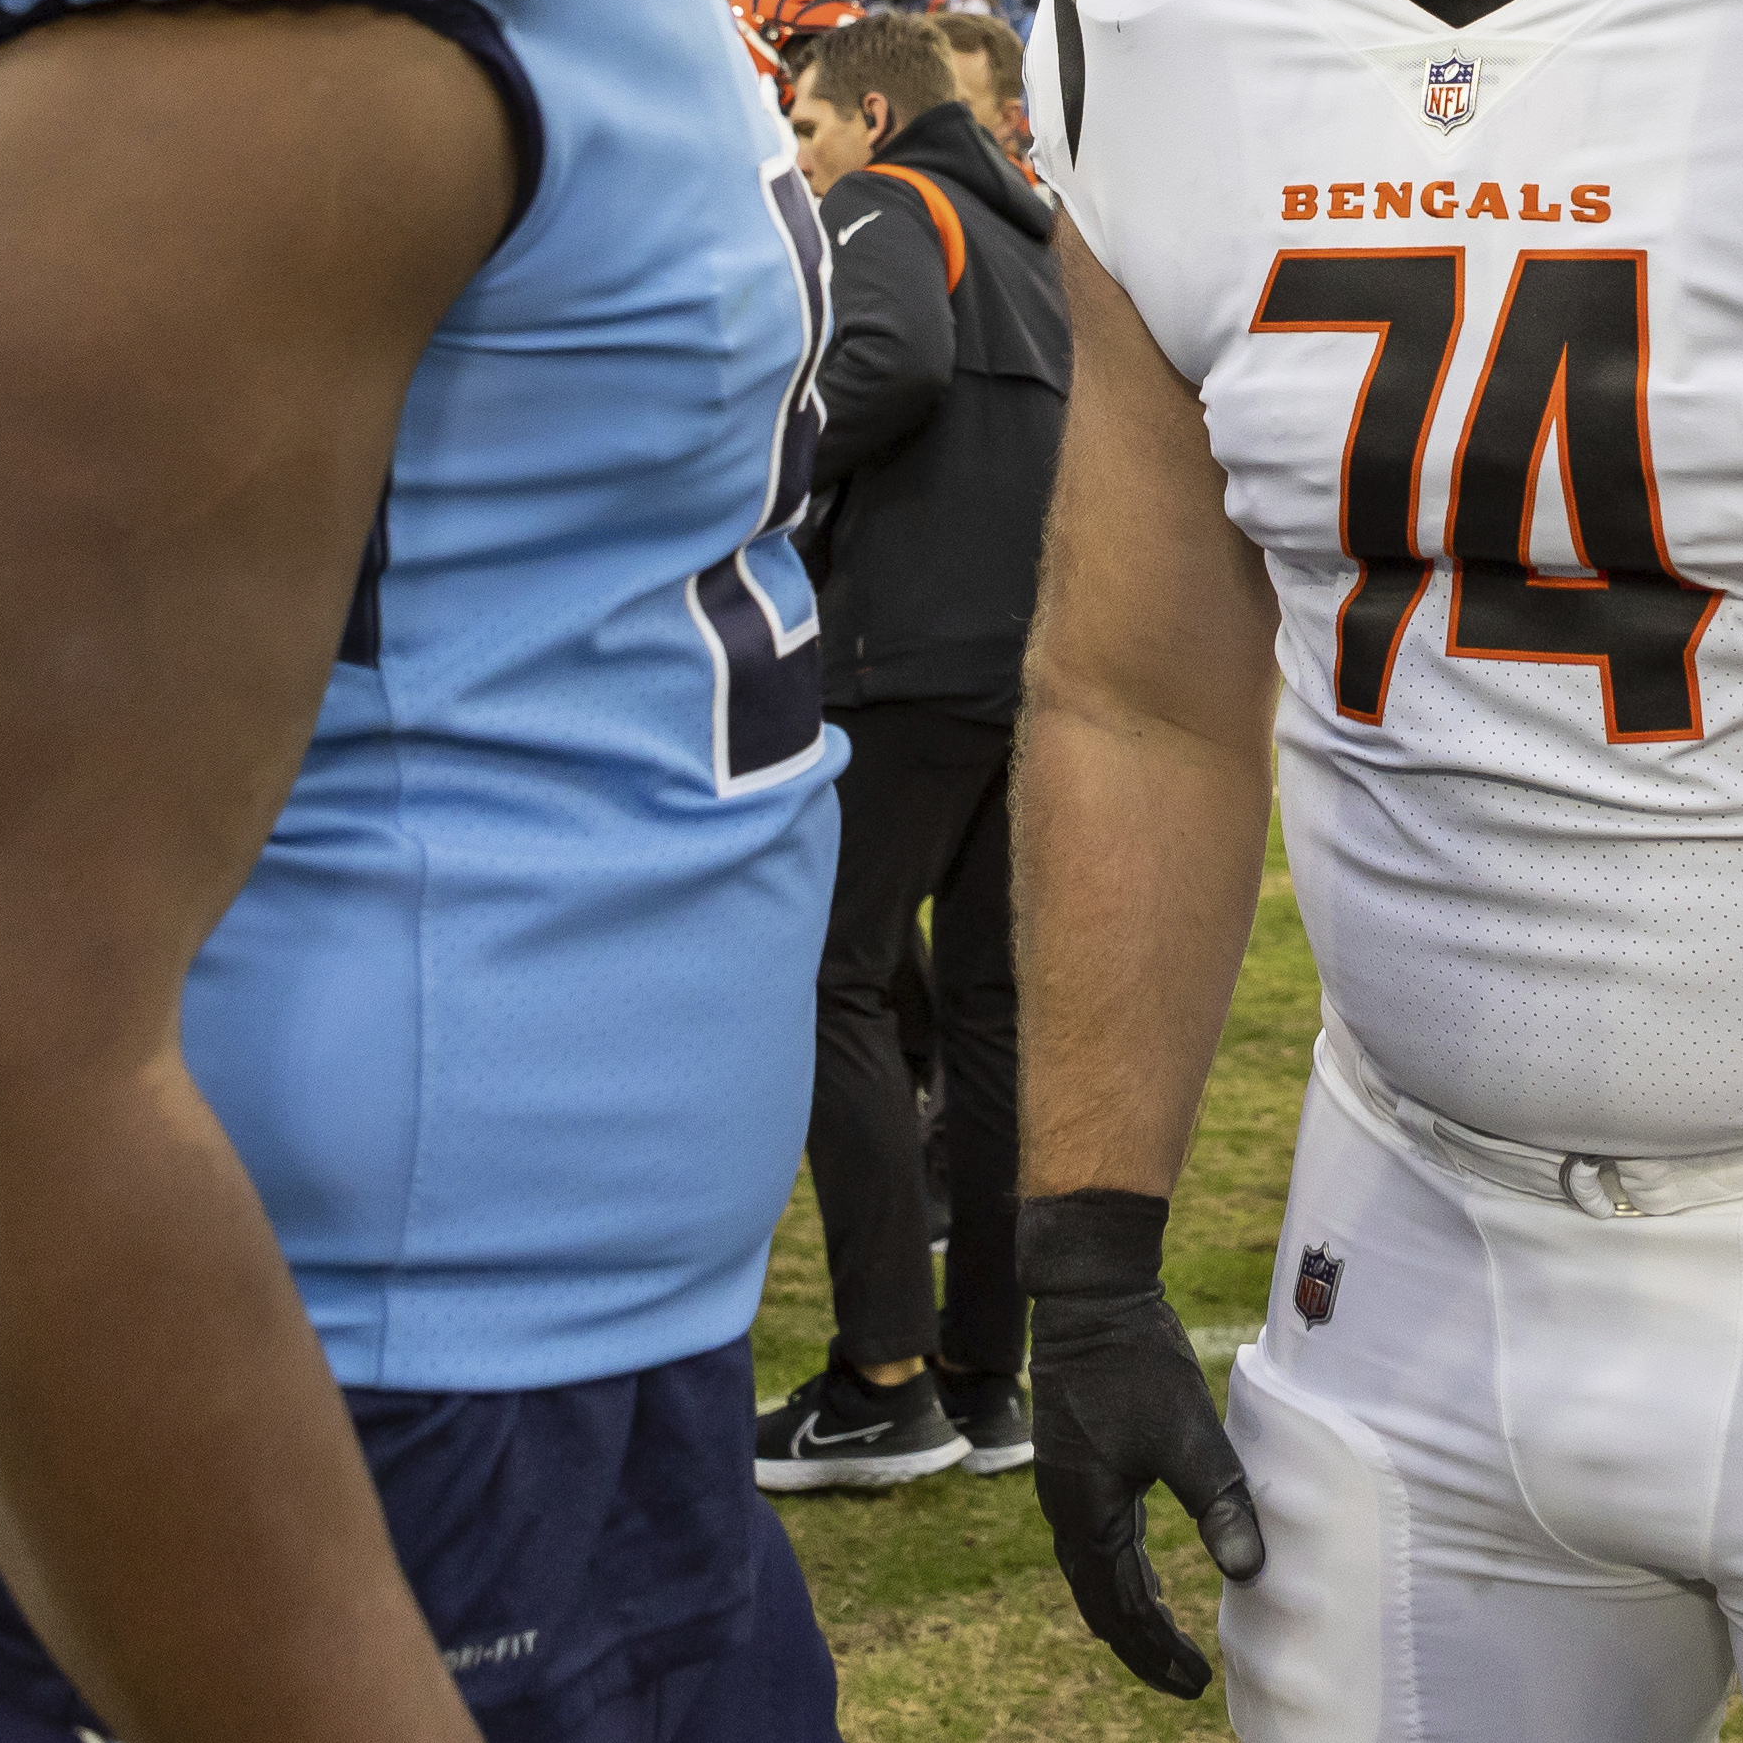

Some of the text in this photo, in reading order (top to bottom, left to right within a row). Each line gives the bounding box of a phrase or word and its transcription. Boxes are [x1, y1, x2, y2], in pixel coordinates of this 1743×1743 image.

[1428, 86, 1467, 119] NFL
[1281, 180, 1612, 223] BENGALS
[1249, 245, 1726, 745] 74
